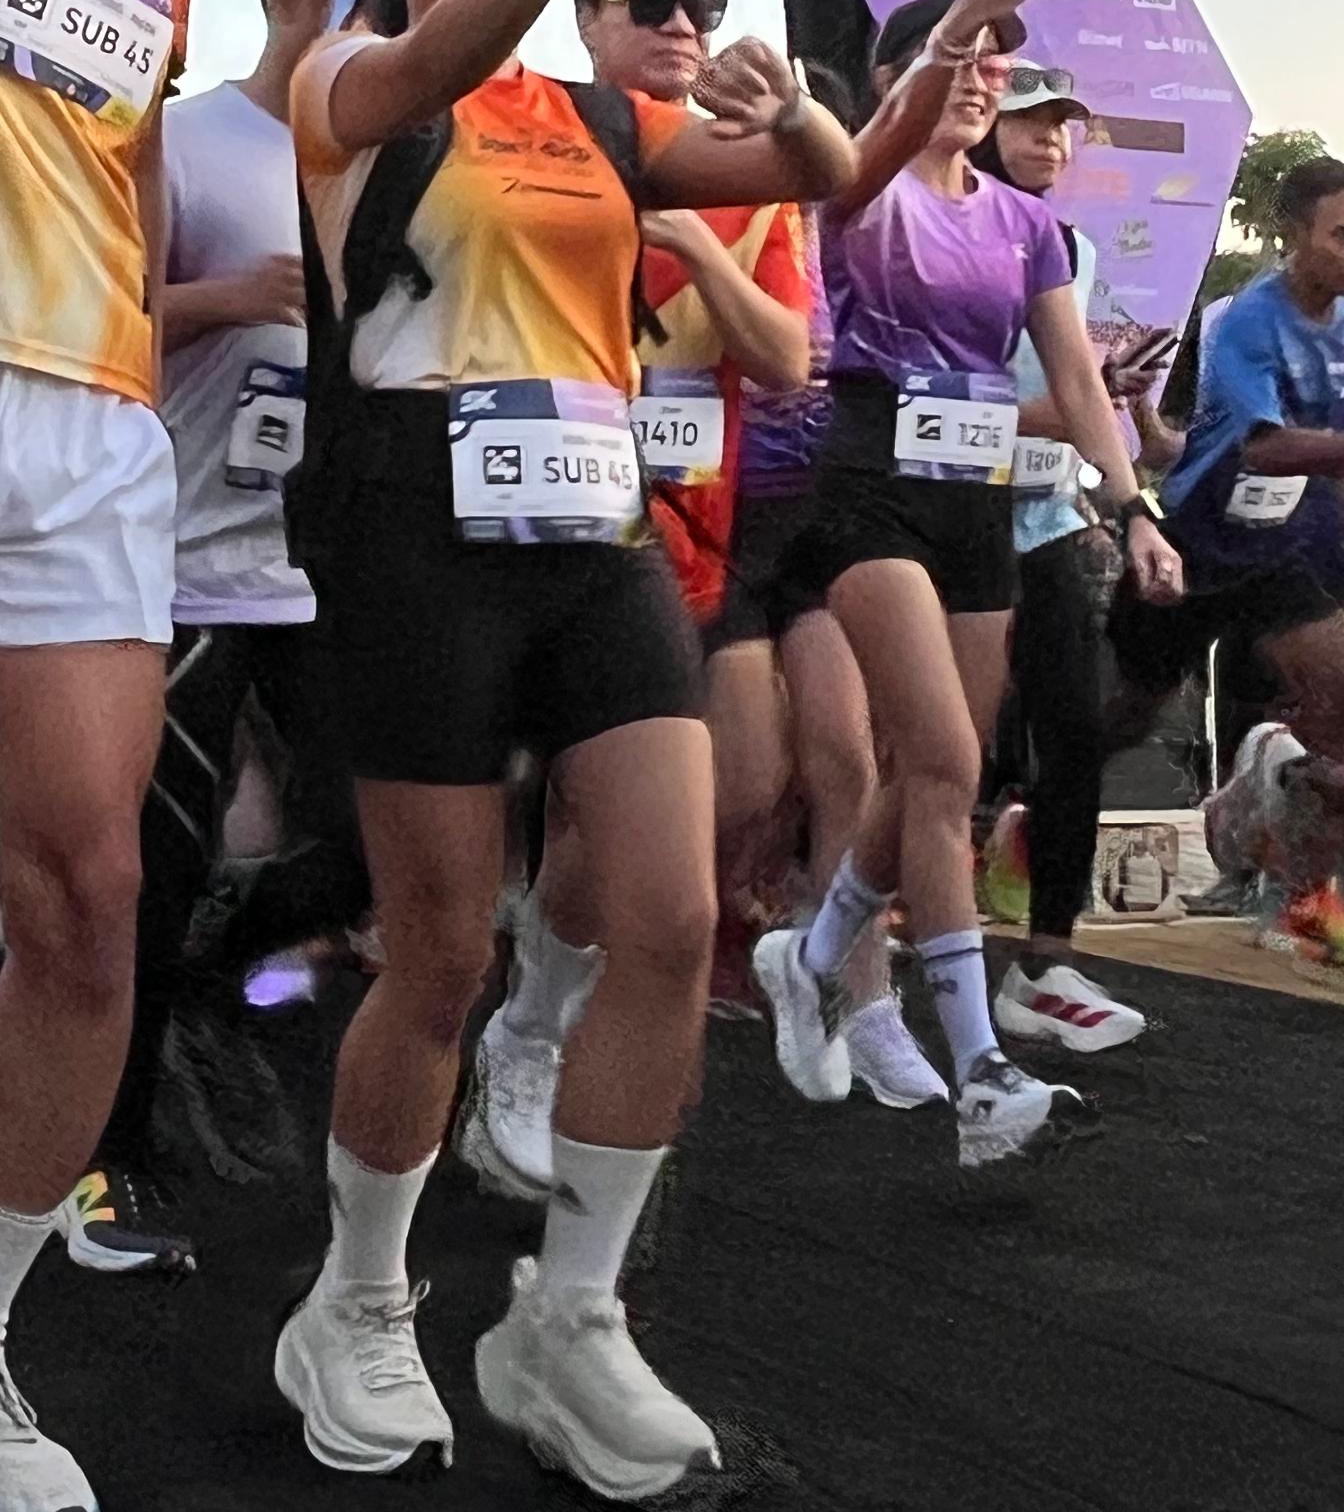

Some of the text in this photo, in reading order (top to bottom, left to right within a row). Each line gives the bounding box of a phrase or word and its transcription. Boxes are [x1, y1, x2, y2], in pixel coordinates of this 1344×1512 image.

[60, 7, 154, 75] SUB 45
[544, 456, 601, 484] SUB
